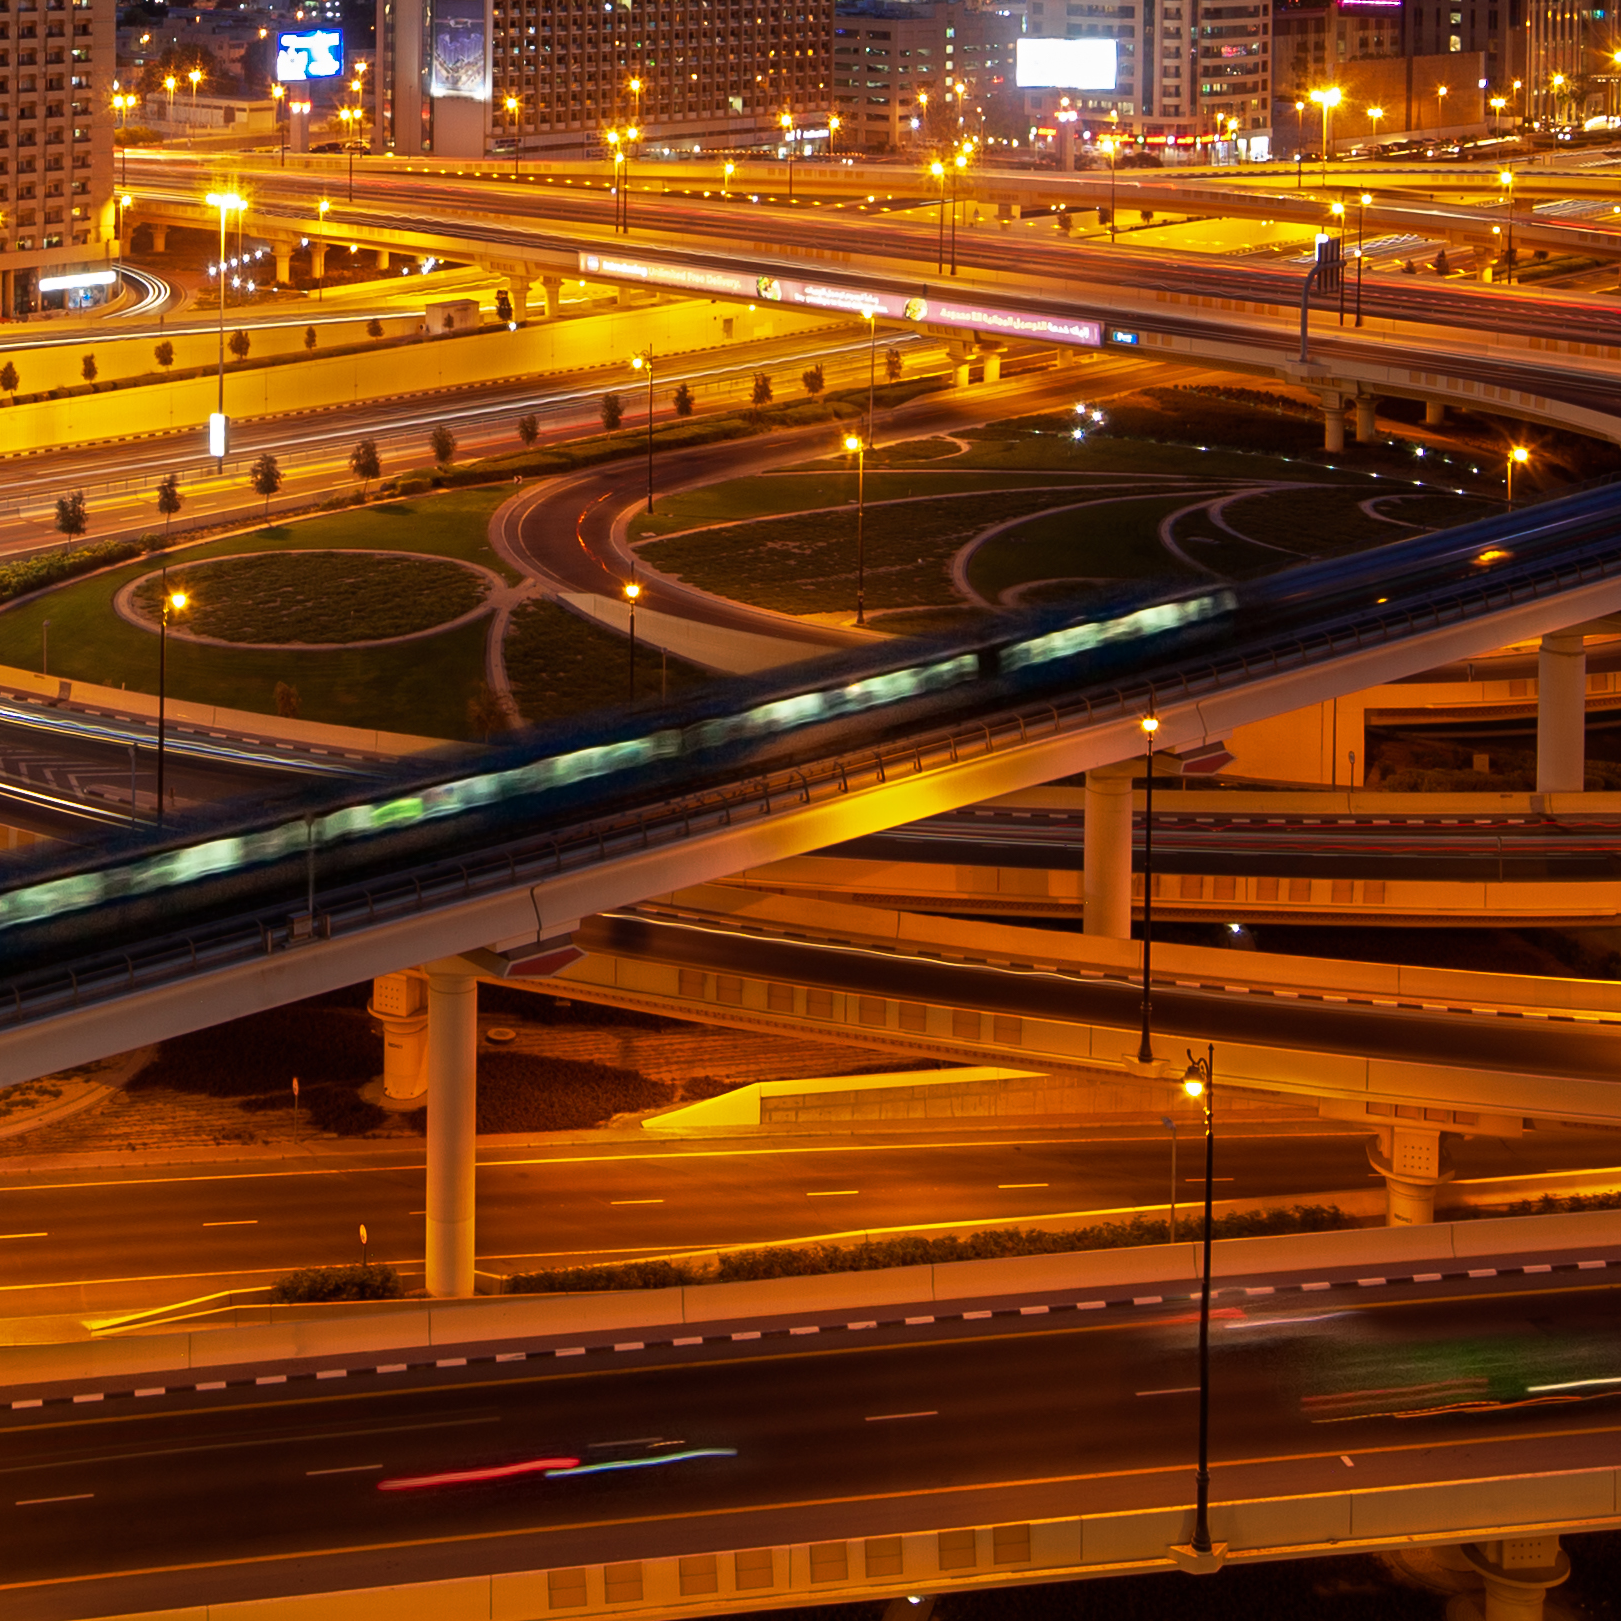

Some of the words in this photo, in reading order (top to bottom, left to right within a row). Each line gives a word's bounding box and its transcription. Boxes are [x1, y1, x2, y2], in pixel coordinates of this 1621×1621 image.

[602, 260, 648, 278] Introducing
[648, 266, 687, 282] Unlimited
[687, 272, 705, 284] Free
